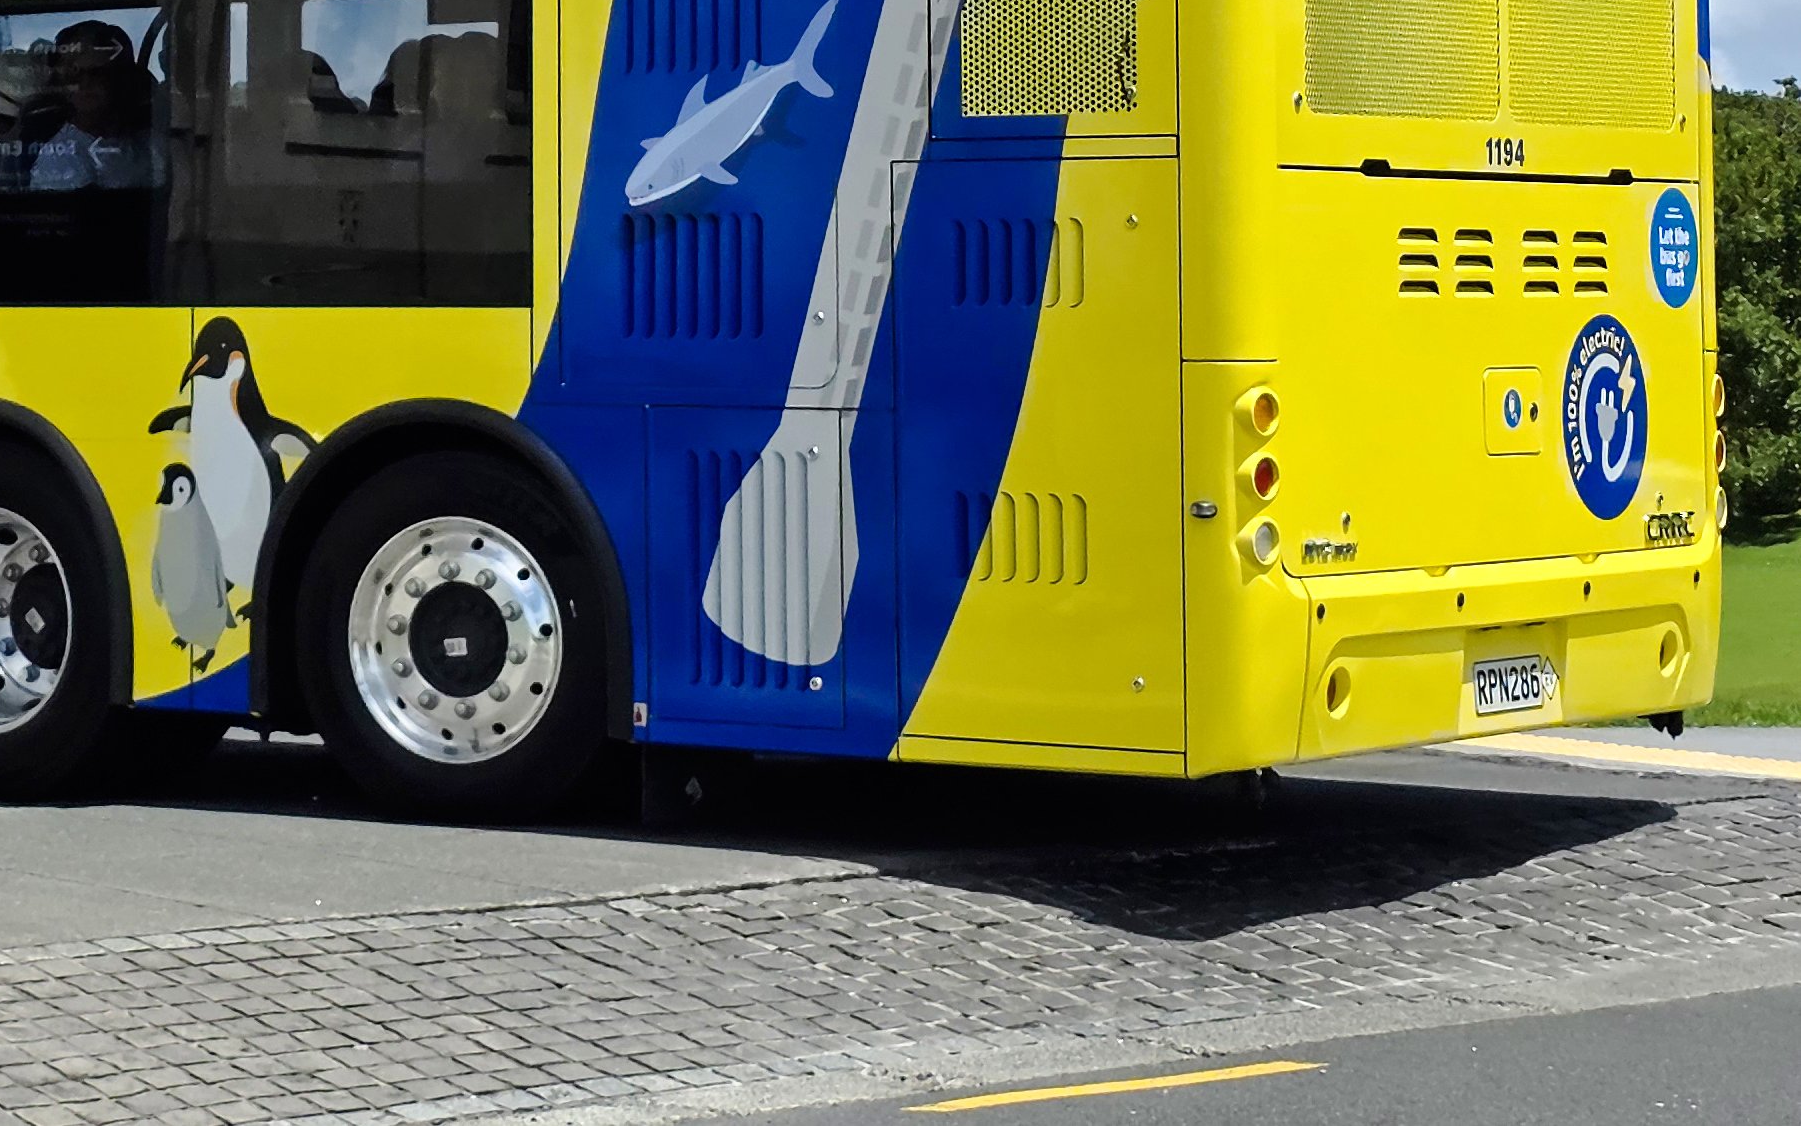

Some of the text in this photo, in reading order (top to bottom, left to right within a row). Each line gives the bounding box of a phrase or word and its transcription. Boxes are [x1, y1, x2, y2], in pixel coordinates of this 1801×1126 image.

[1485, 137, 1525, 168] 1194
[1658, 225, 1674, 245] Let
[1567, 364, 1583, 434] 100%
[1579, 326, 1626, 366] electric!
[1476, 662, 1540, 706] RPN286
